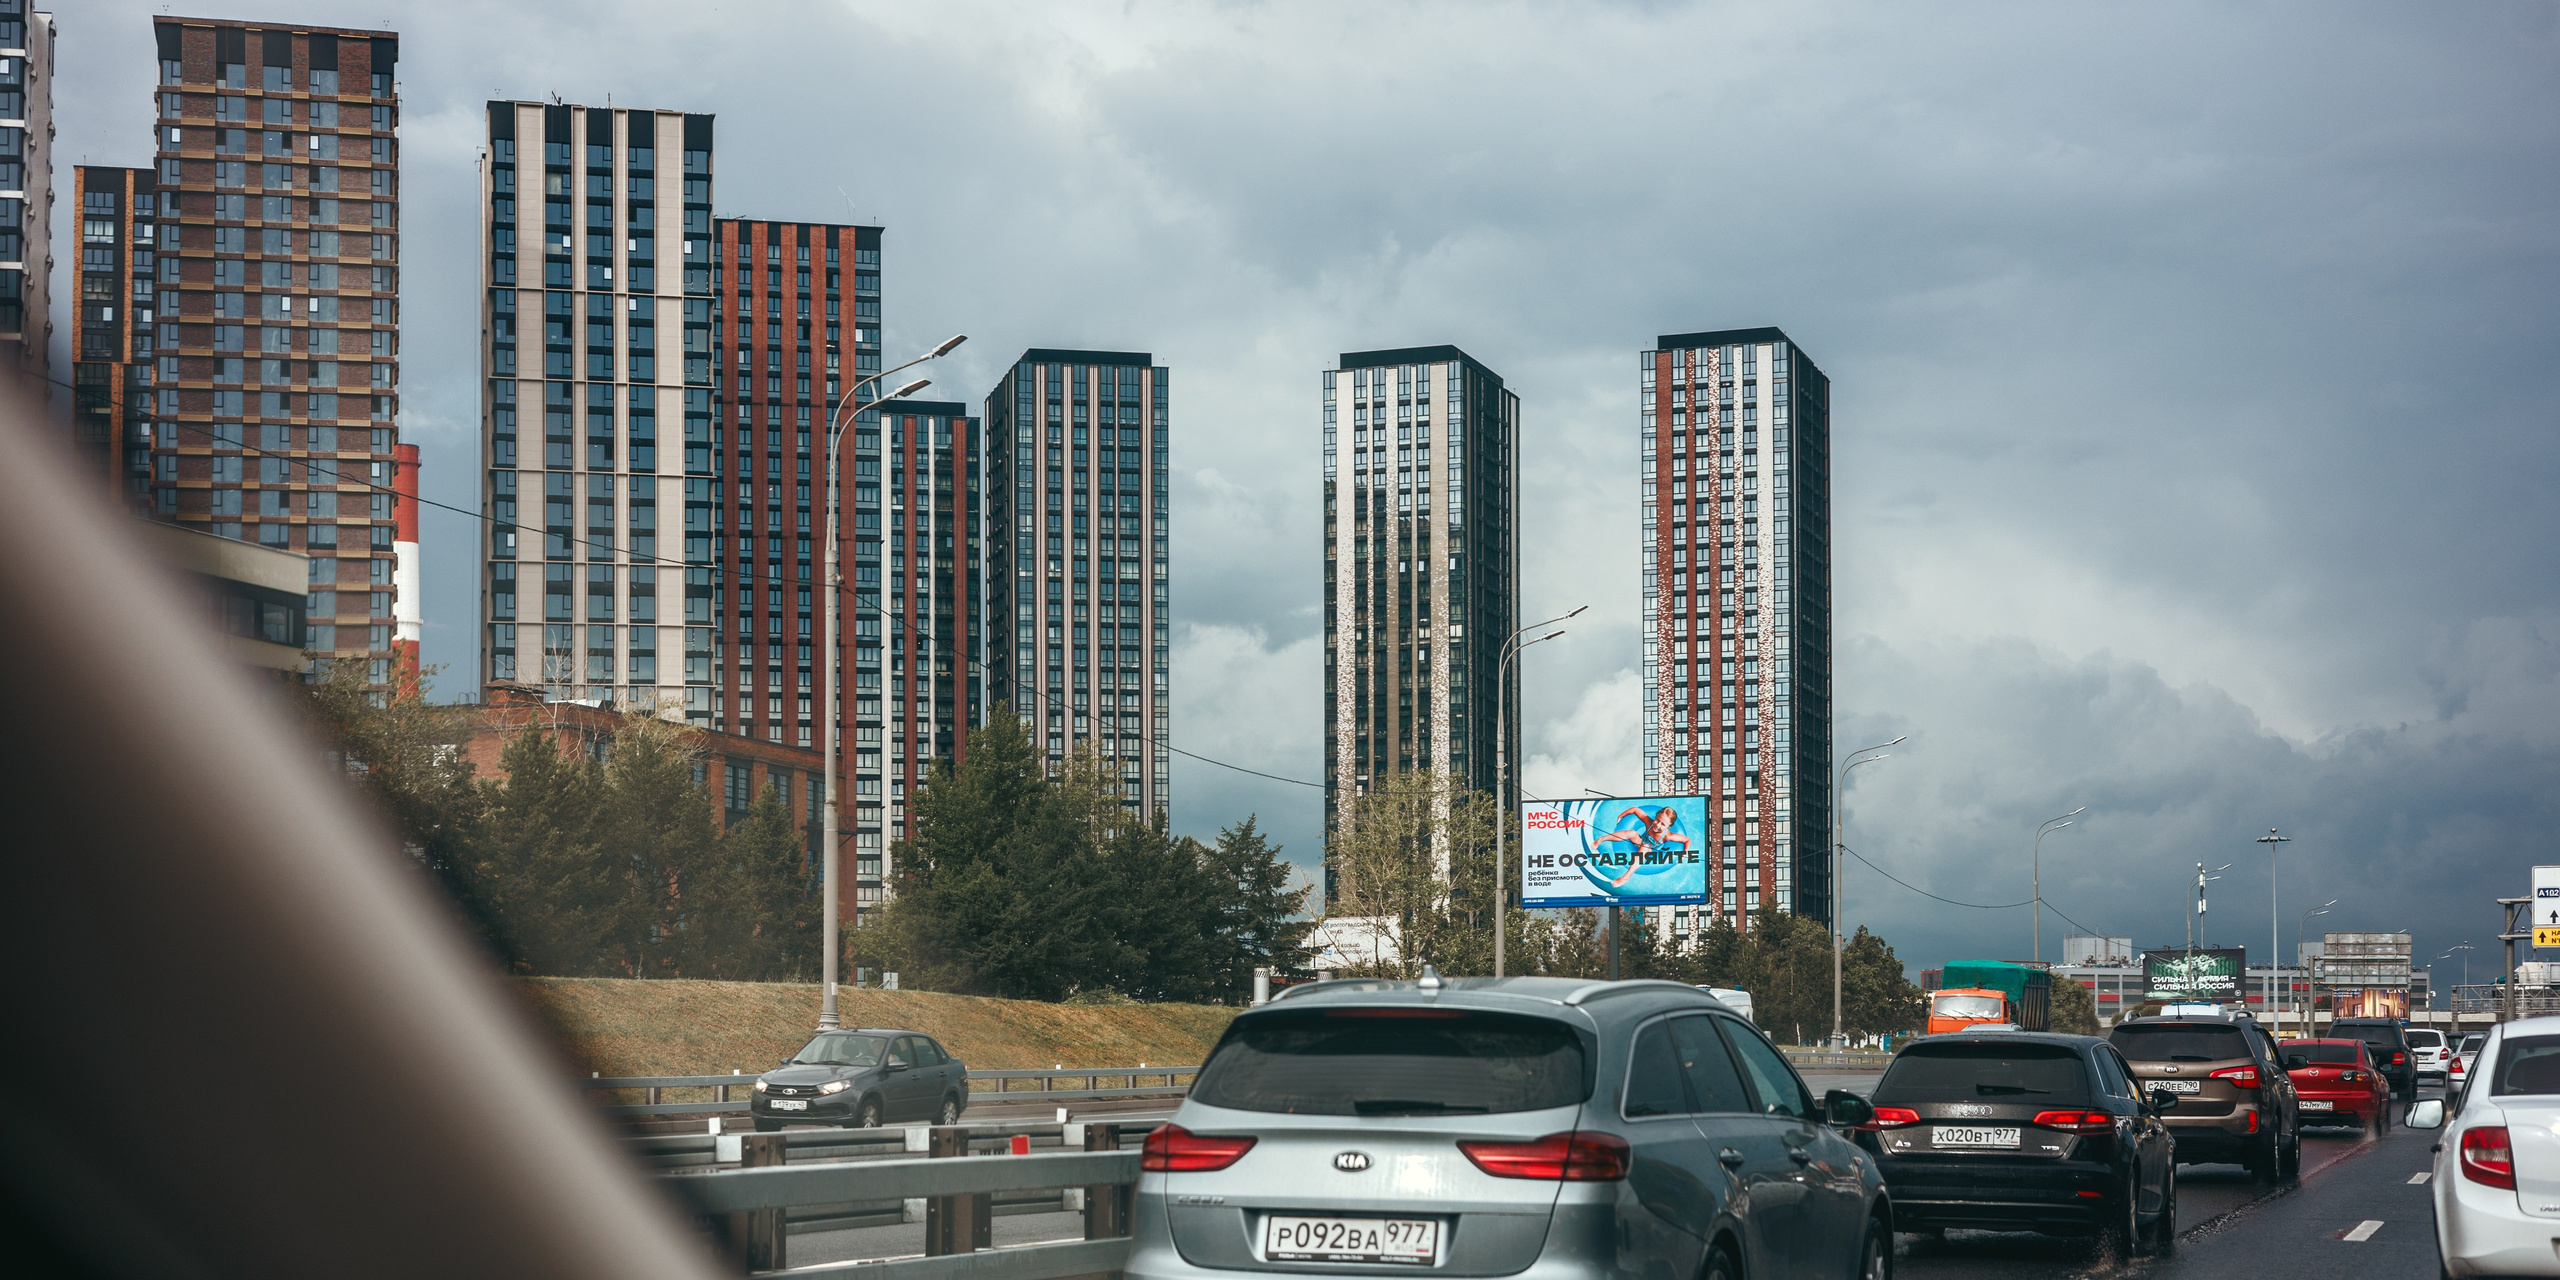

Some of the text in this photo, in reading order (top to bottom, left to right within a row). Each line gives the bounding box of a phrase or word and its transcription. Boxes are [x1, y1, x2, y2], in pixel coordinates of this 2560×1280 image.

[1528, 811, 1558, 820] МЧС
[1528, 820, 1585, 829] РОССИИ
[1528, 848, 1700, 868] НЕ ОСТАВЛЯЙТЕ
[2198, 982, 2235, 990] РОССИЯ
[1936, 1128, 2017, 1143] Х020ВТ 977
[1337, 1154, 1367, 1168] KIA
[1277, 1222, 1427, 1250] Р092ВА 977
